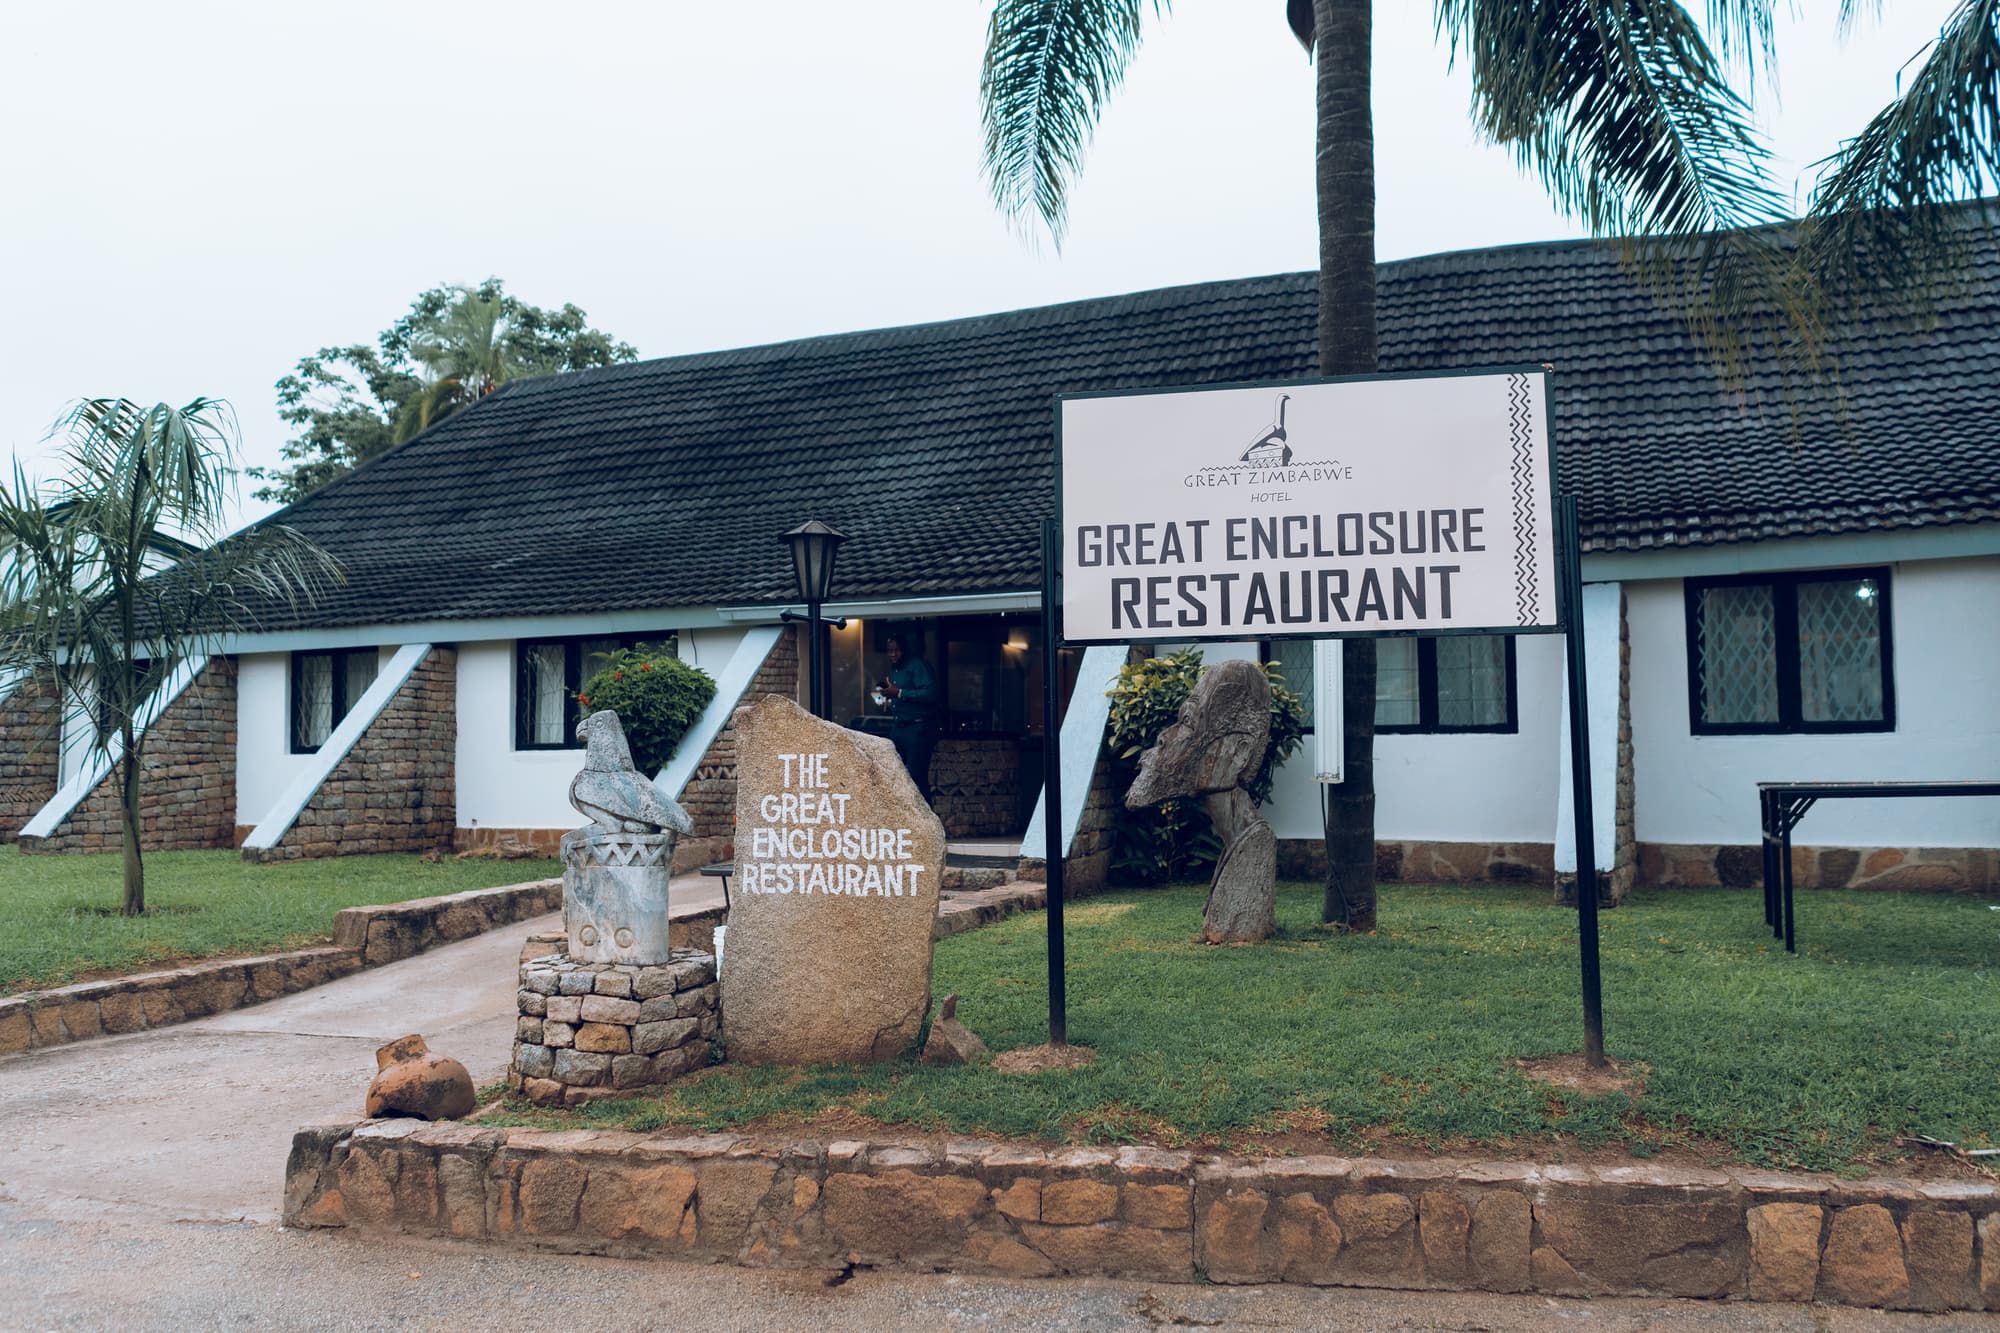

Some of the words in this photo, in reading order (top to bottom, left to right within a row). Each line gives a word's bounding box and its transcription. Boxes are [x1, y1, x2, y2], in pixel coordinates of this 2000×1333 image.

[1183, 472, 1241, 488] GREAT
[1248, 466, 1353, 484] ZIMBABWE
[1250, 492, 1292, 503] HOTEL
[1077, 519, 1210, 567] GREAT
[1226, 508, 1486, 560] ENCLOSURE
[1111, 564, 1461, 629] RESTAURANT
[777, 753, 830, 789] THE
[760, 793, 851, 825] GREAT
[752, 827, 913, 861] ENCLOSURE
[742, 863, 925, 897] RESTAURANT
